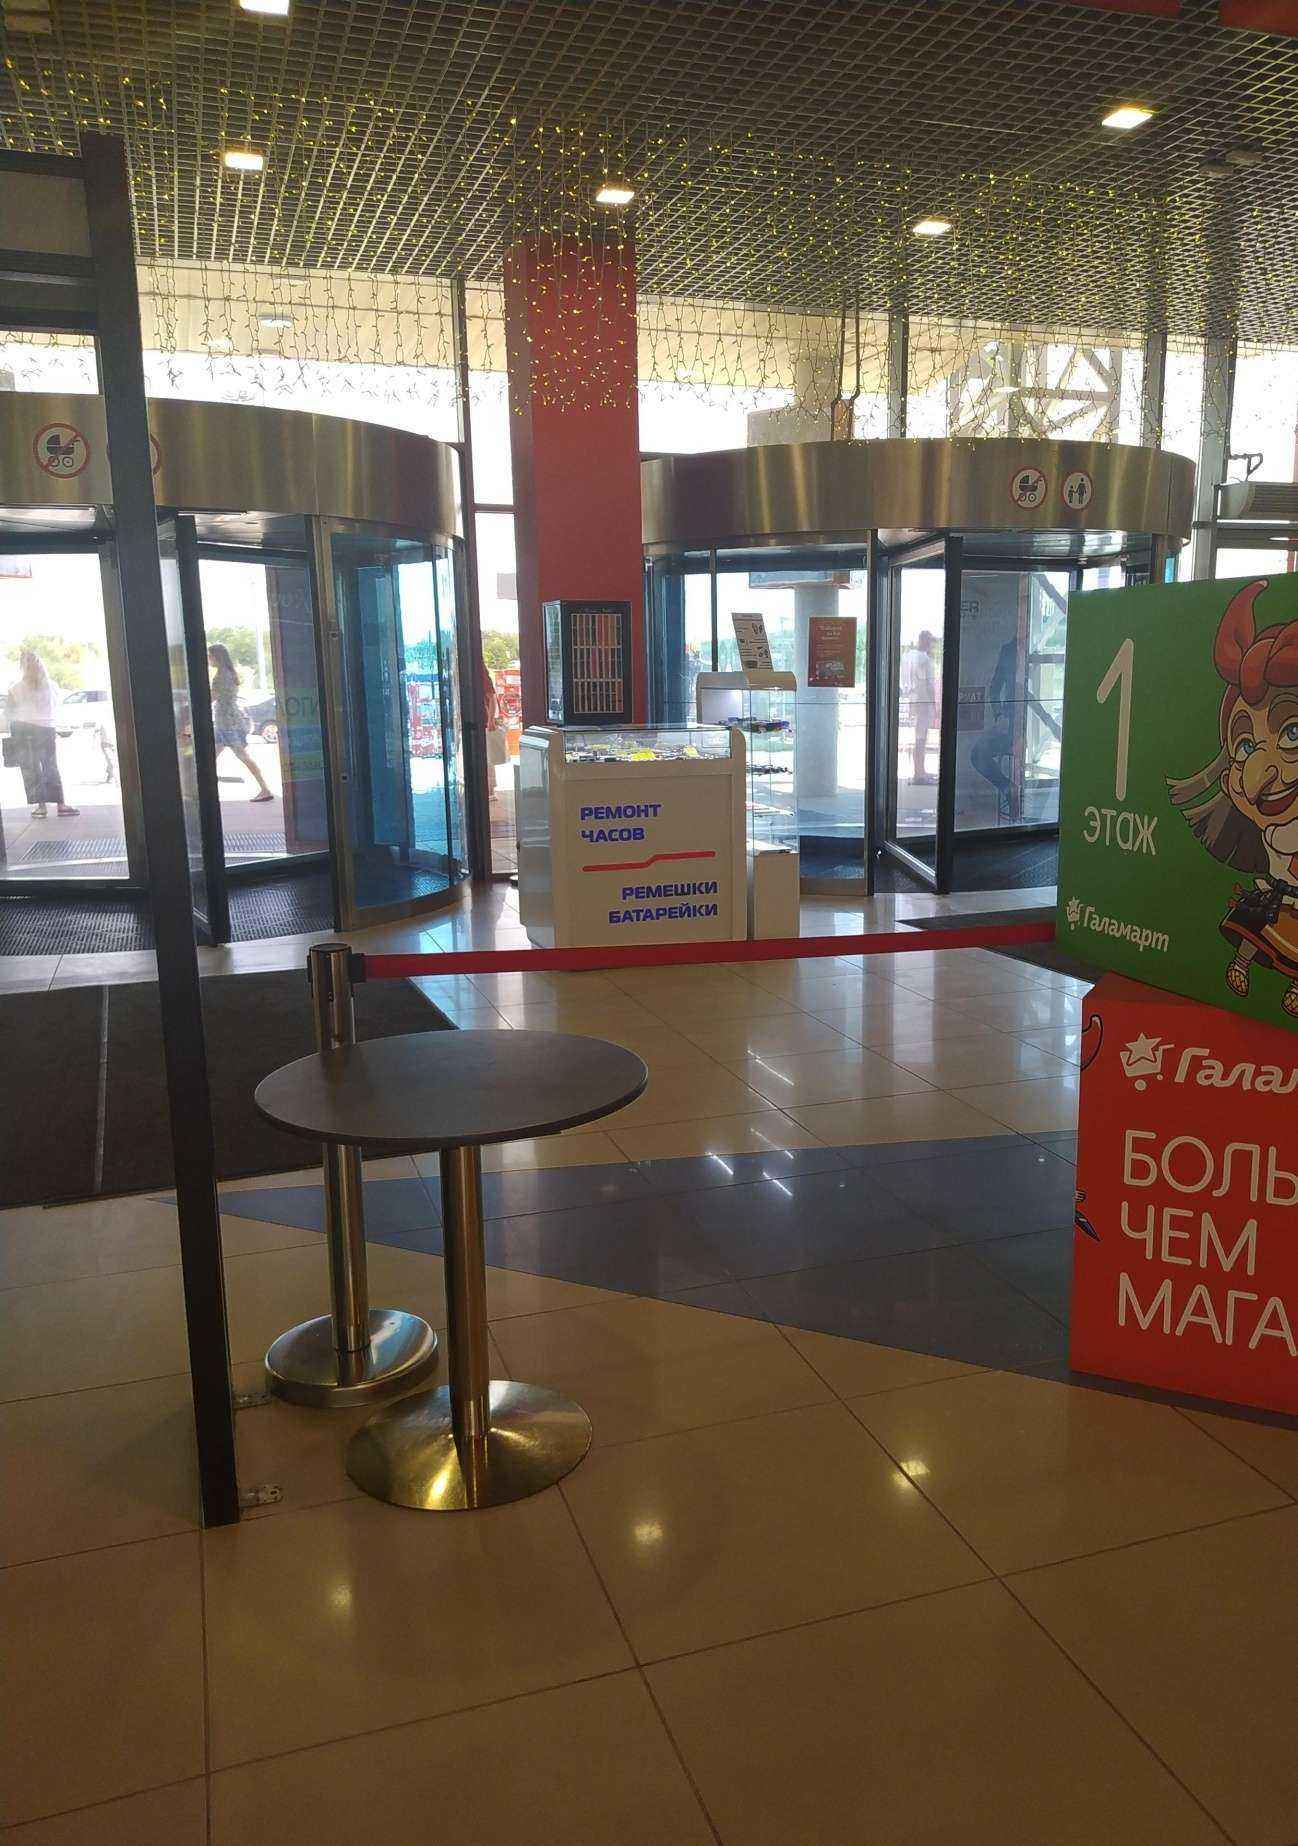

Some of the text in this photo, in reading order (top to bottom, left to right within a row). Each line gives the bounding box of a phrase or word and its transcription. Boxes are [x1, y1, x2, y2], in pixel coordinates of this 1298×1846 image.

[580, 804, 661, 821] РЕМОНТ
[581, 827, 645, 843] ЧАСОВ
[1083, 806, 1158, 856] ЭТАЖ
[621, 881, 717, 901] РЕМЕШКИ
[608, 903, 717, 924] БАТАРЕЙКИ
[1083, 904, 1170, 953] Галамарт
[1120, 1200, 1259, 1277] ЧЕМ
[1118, 1271, 1298, 1358] МАГА
